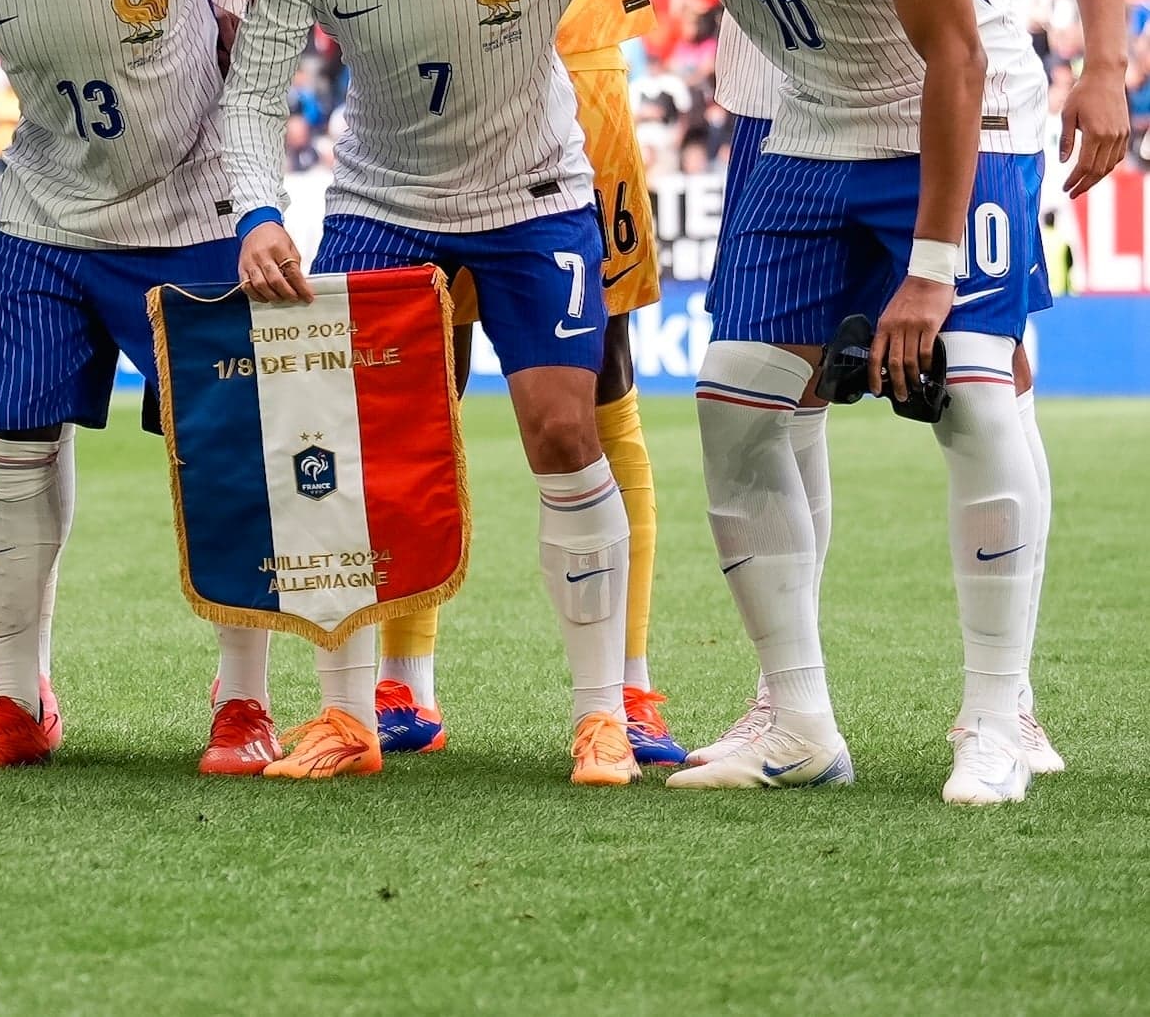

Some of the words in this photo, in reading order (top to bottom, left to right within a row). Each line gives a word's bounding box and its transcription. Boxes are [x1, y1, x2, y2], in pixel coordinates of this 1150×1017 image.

[418, 62, 452, 116] 7
[56, 80, 126, 142] 13
[553, 251, 586, 319] 7
[250, 326, 300, 343] EURO
[307, 320, 358, 339] 2024
[213, 357, 255, 380] 1/8
[260, 355, 297, 375] DE
[304, 348, 401, 372] FINALE
[302, 483, 331, 491] FRANCE
[258, 554, 333, 572] JUILLET
[340, 549, 393, 567] 2024
[268, 571, 389, 594] ALLEMAGNE
